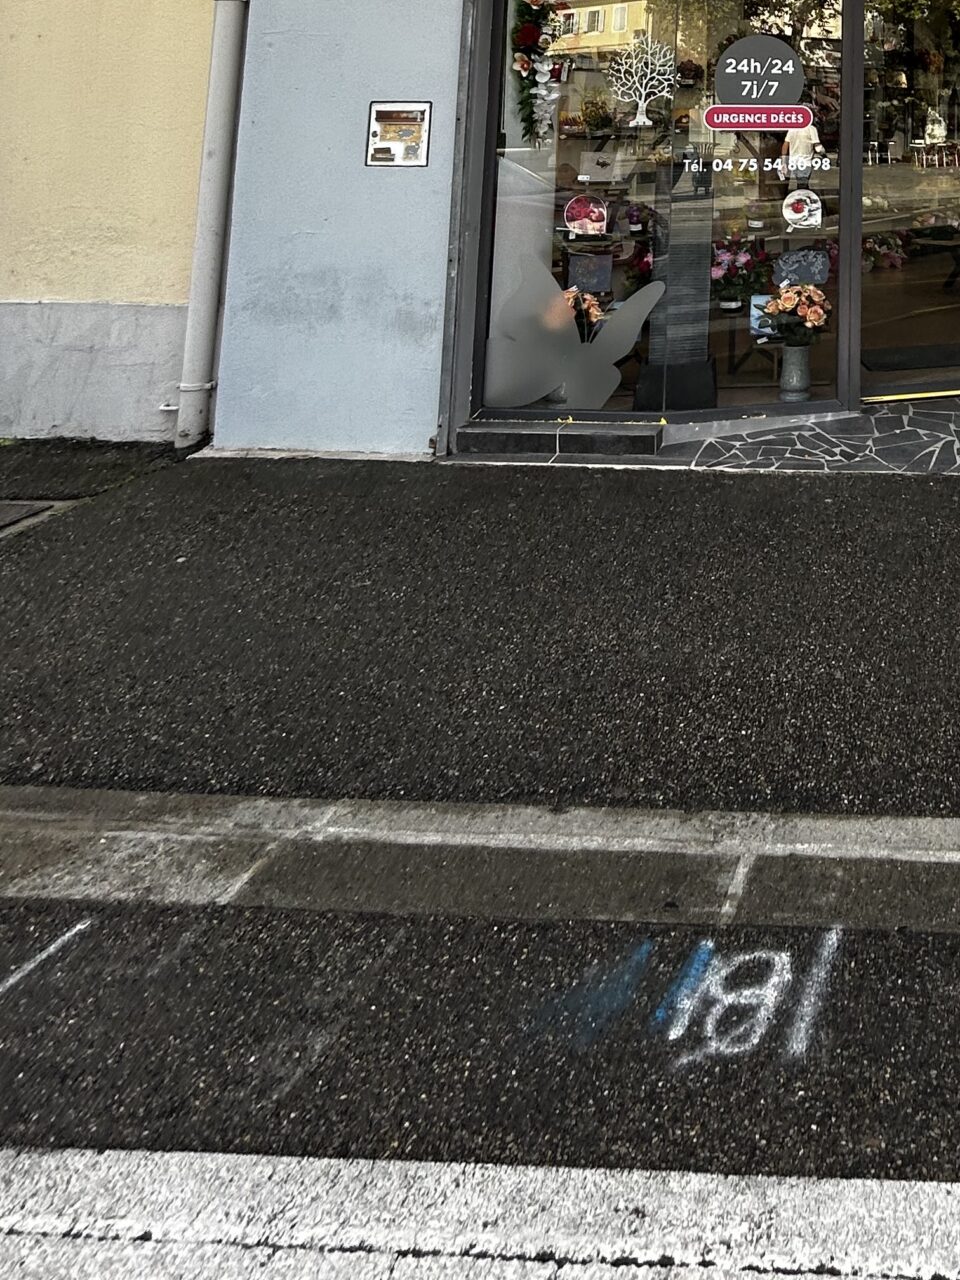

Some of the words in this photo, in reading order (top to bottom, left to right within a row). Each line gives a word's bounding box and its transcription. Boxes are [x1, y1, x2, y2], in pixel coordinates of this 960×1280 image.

[725, 58, 795, 76] 24h/24
[741, 80, 779, 99] 7j/7
[713, 113, 767, 123] URGENCE
[770, 111, 804, 123] DÉCÈS
[683, 158, 707, 172] Tél.
[712, 158, 733, 171] 04
[738, 158, 758, 171] 75
[763, 158, 783, 171] 54
[811, 158, 831, 172] 98
